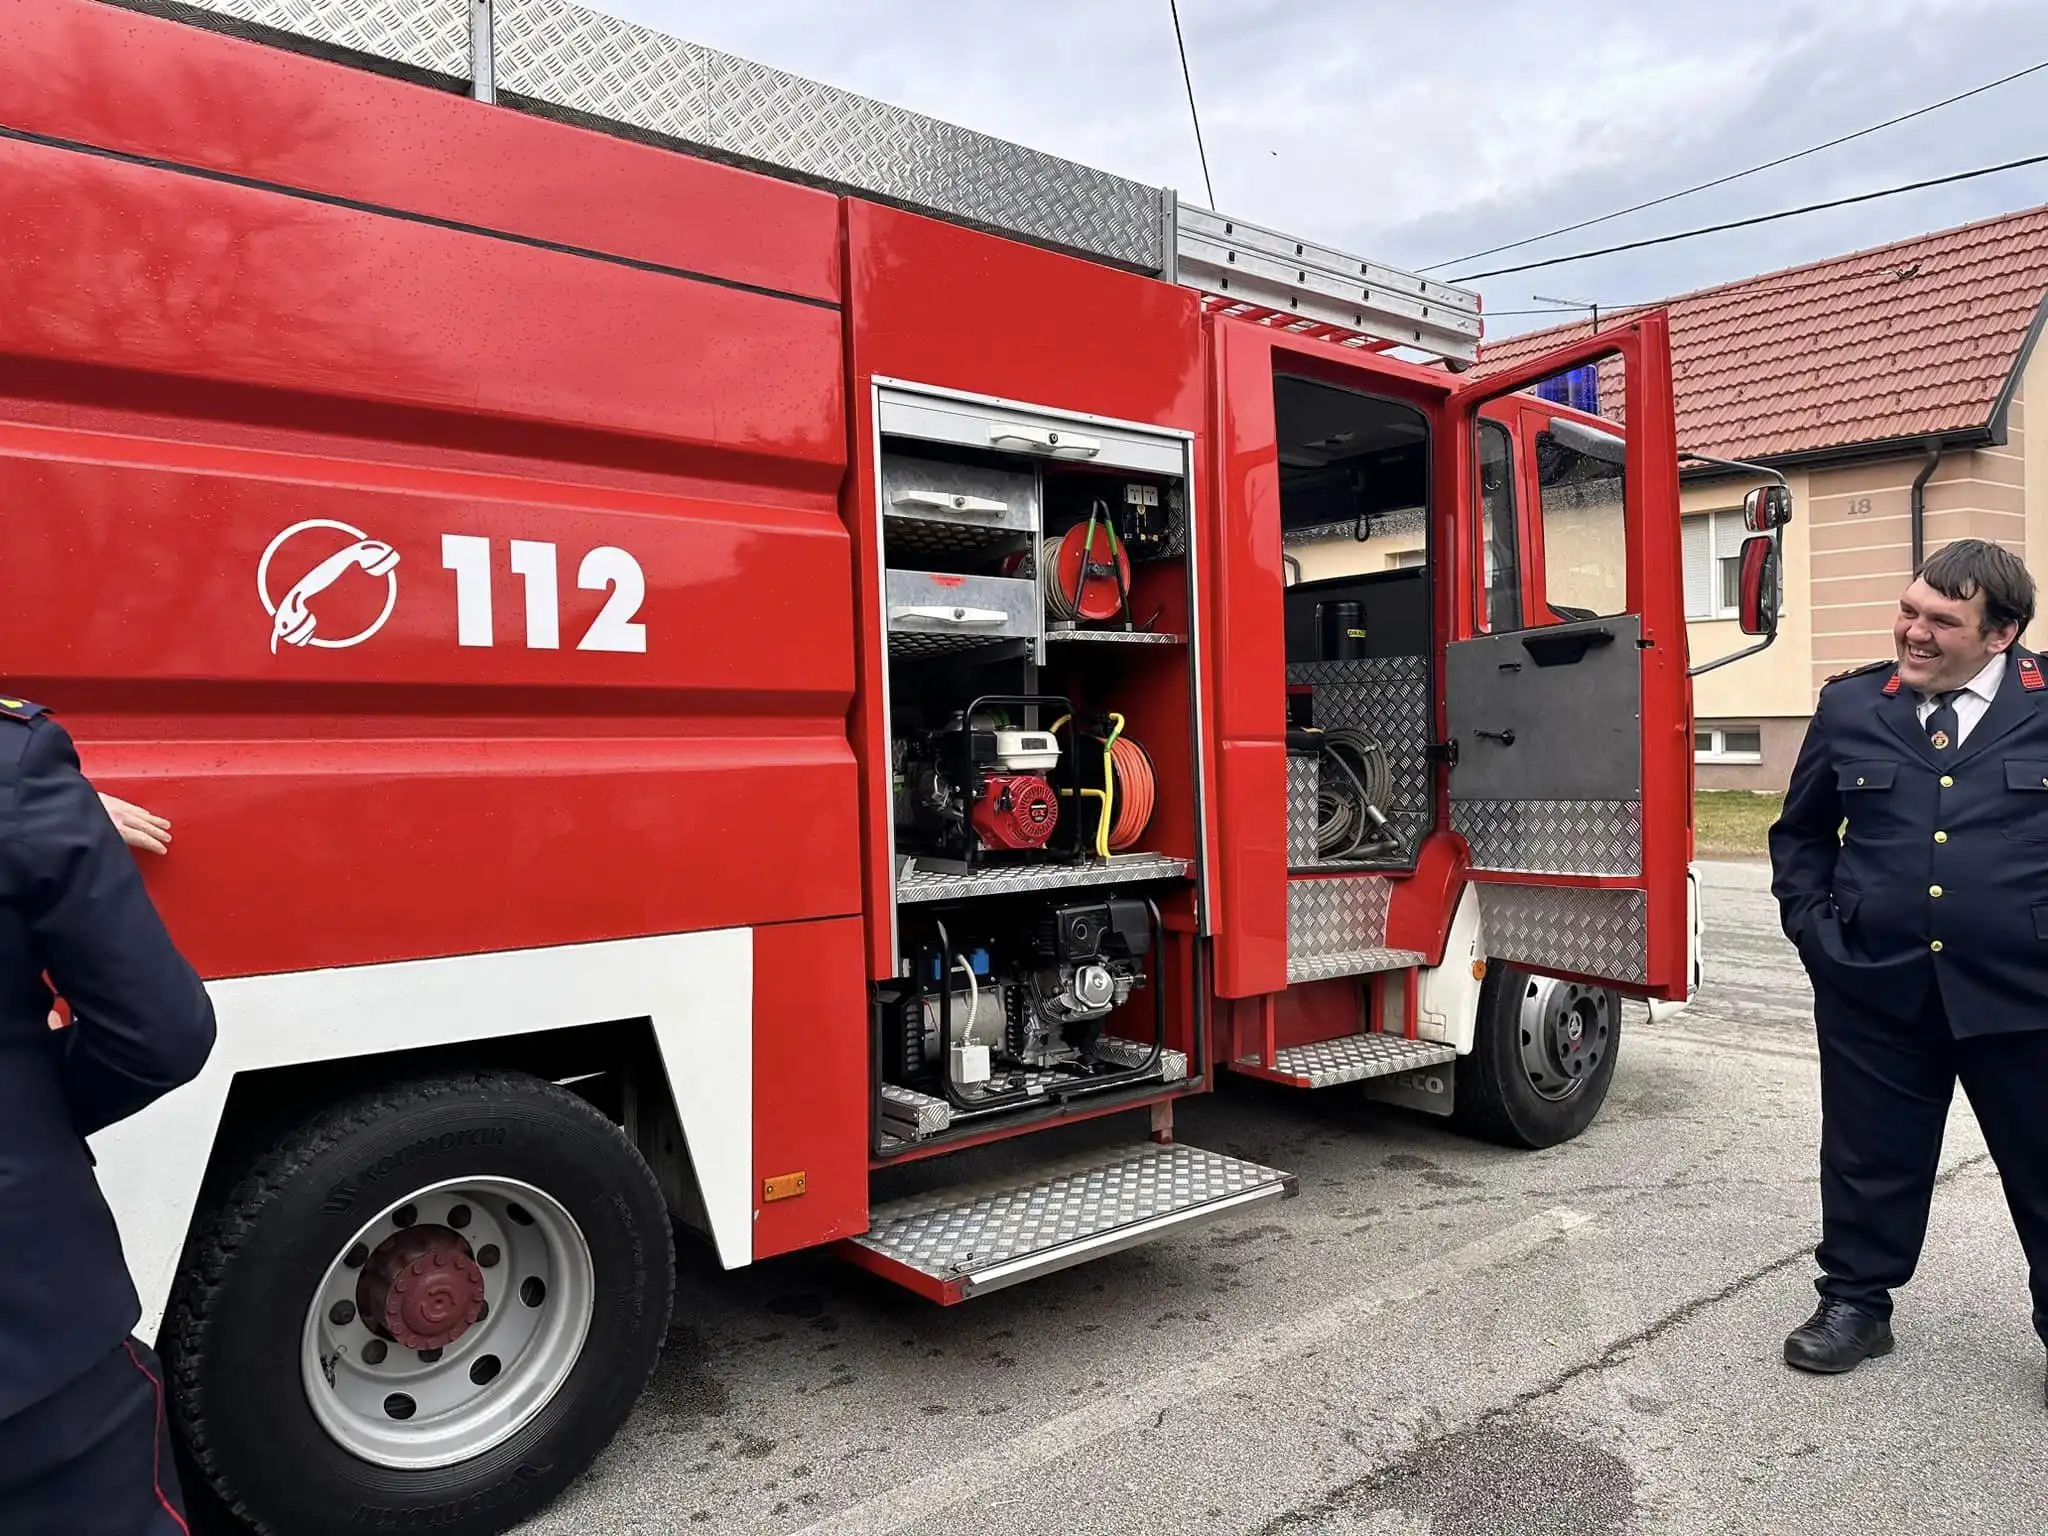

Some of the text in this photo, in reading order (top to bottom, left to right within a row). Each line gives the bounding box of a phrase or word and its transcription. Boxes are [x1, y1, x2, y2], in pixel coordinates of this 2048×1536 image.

[1847, 498, 1872, 515] 18
[441, 533, 647, 653] 112
[1384, 1074, 1444, 1094] VECO
